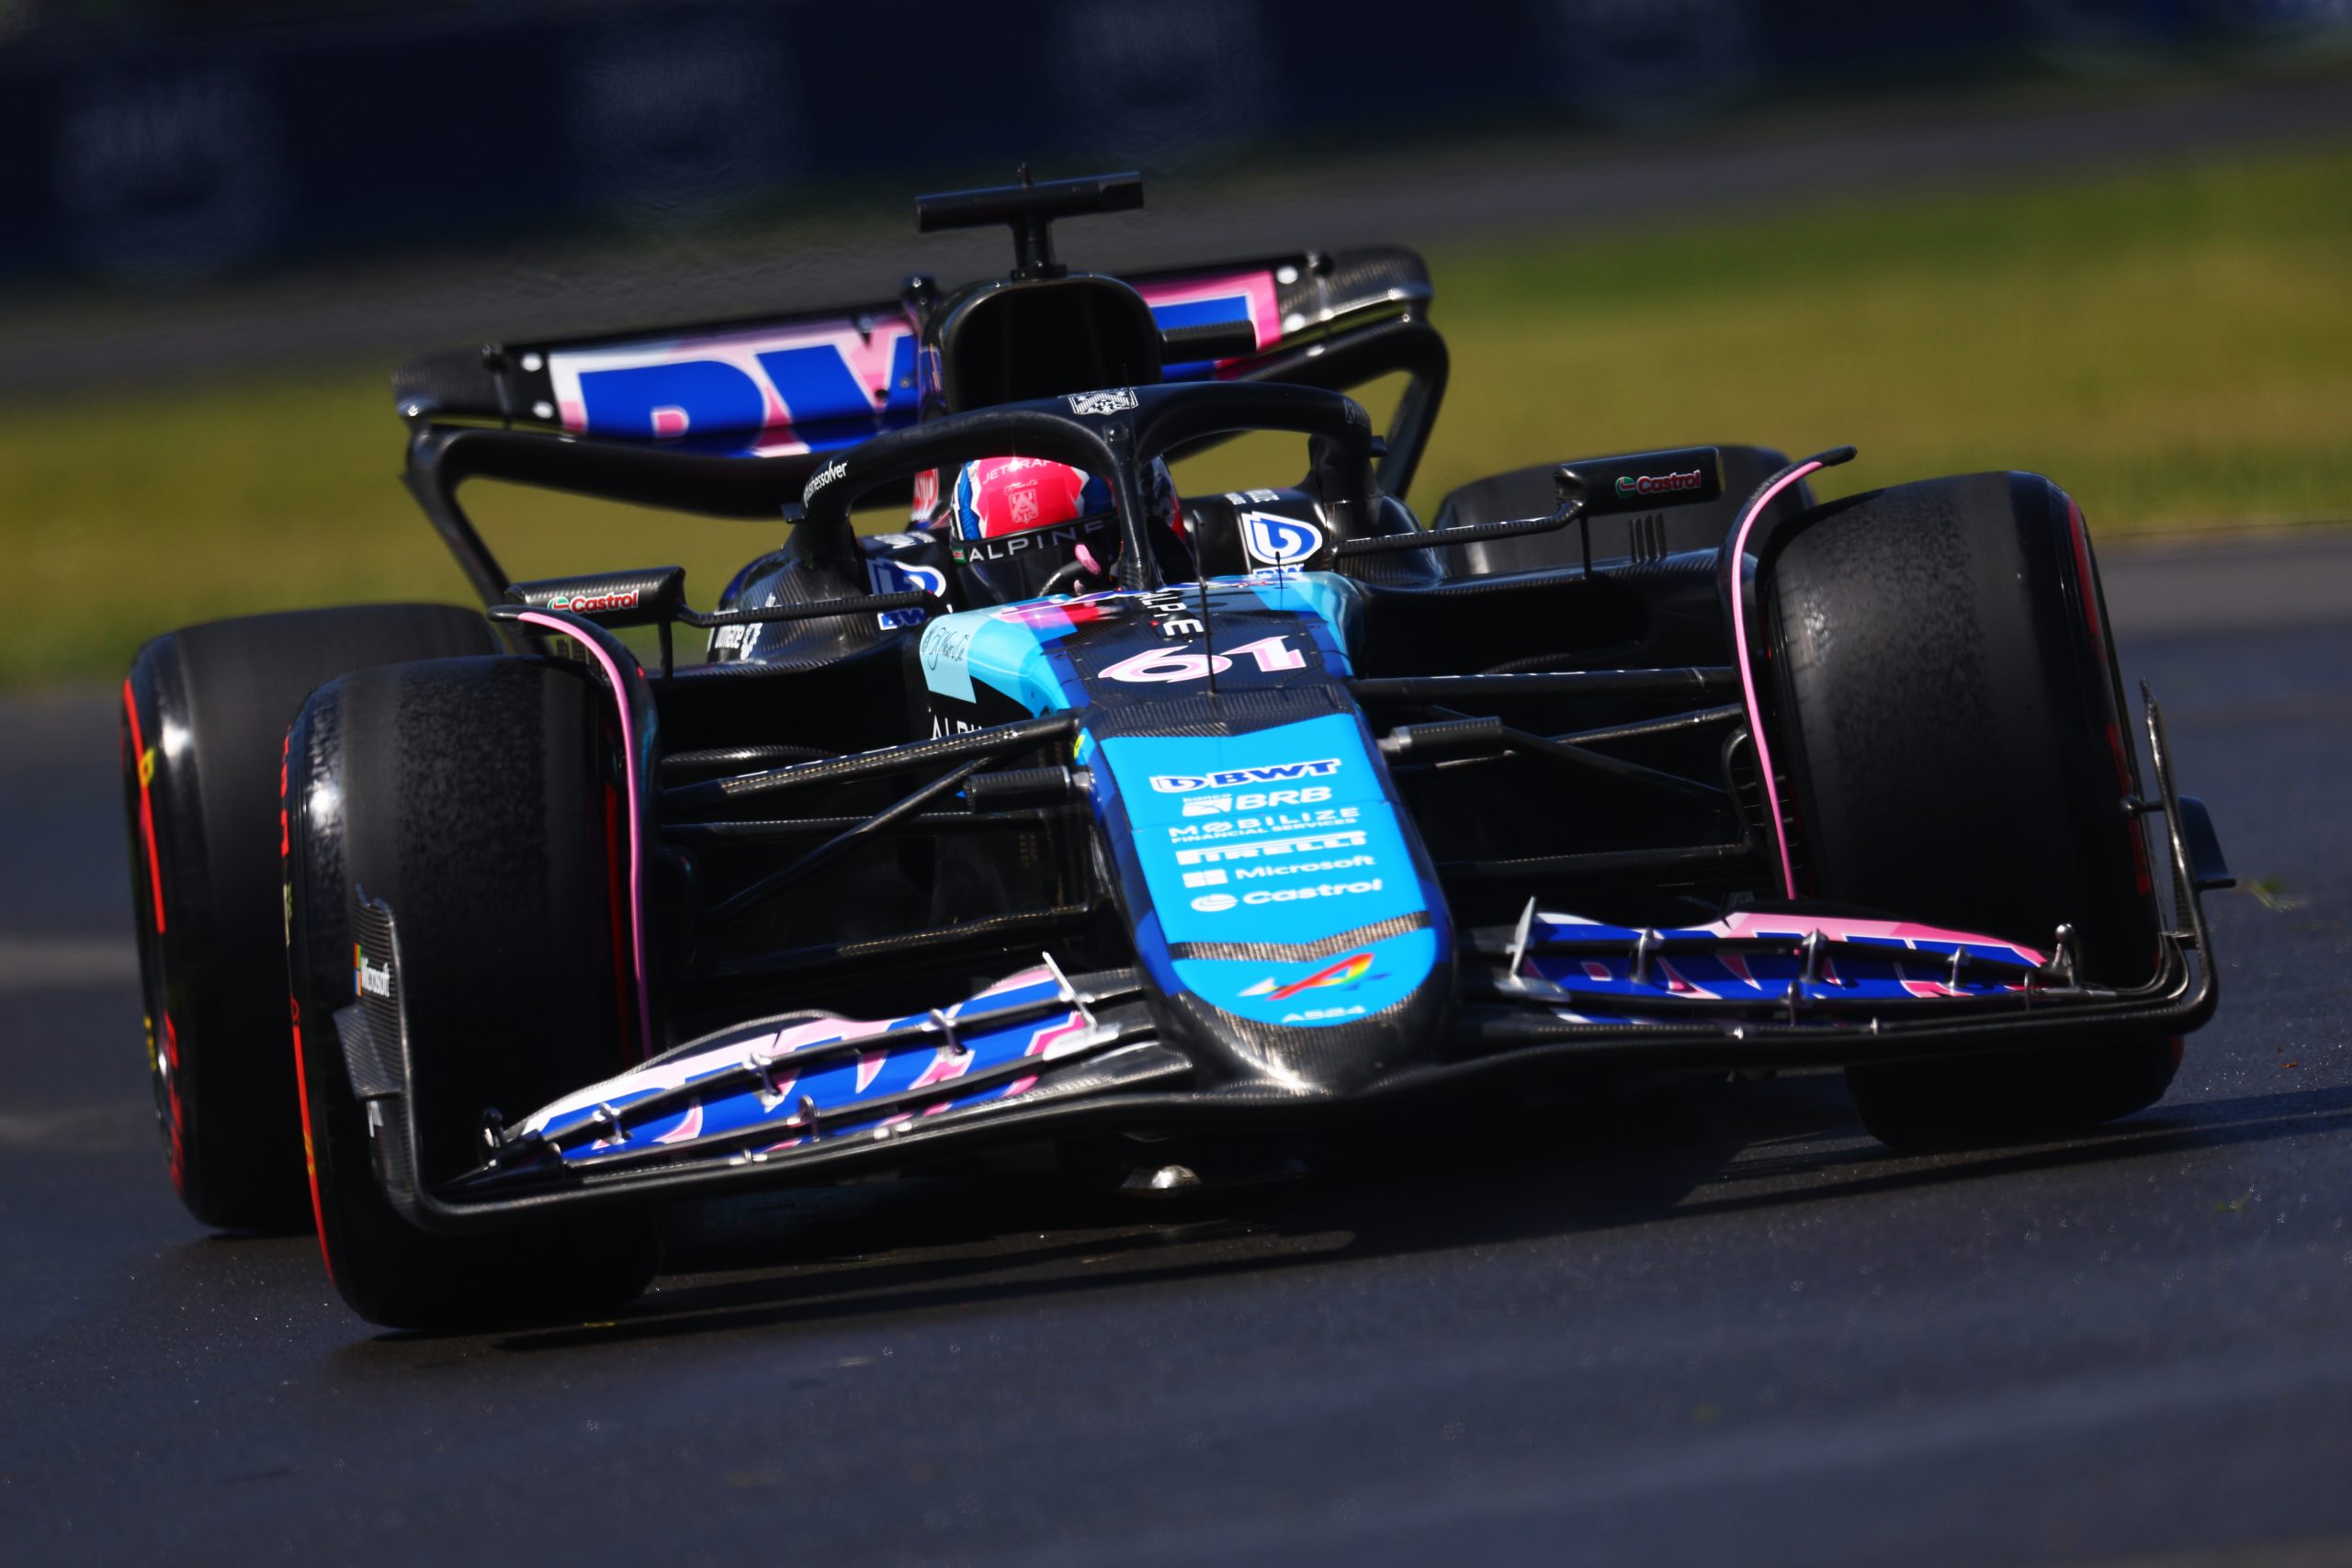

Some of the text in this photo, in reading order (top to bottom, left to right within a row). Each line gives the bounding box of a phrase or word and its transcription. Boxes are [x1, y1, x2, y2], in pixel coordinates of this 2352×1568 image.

[1636, 469, 1701, 495] Castrol
[570, 589, 639, 615] Castrol
[1098, 635, 1306, 683] 61
[1206, 759, 1341, 788] BWT
[1236, 786, 1332, 810] BRB
[1170, 818, 1358, 843] FINANCIAL SERVICES
[1175, 829, 1367, 865] PIRELLI
[1236, 854, 1377, 879] Microsoft
[1242, 877, 1383, 905] Castrol
